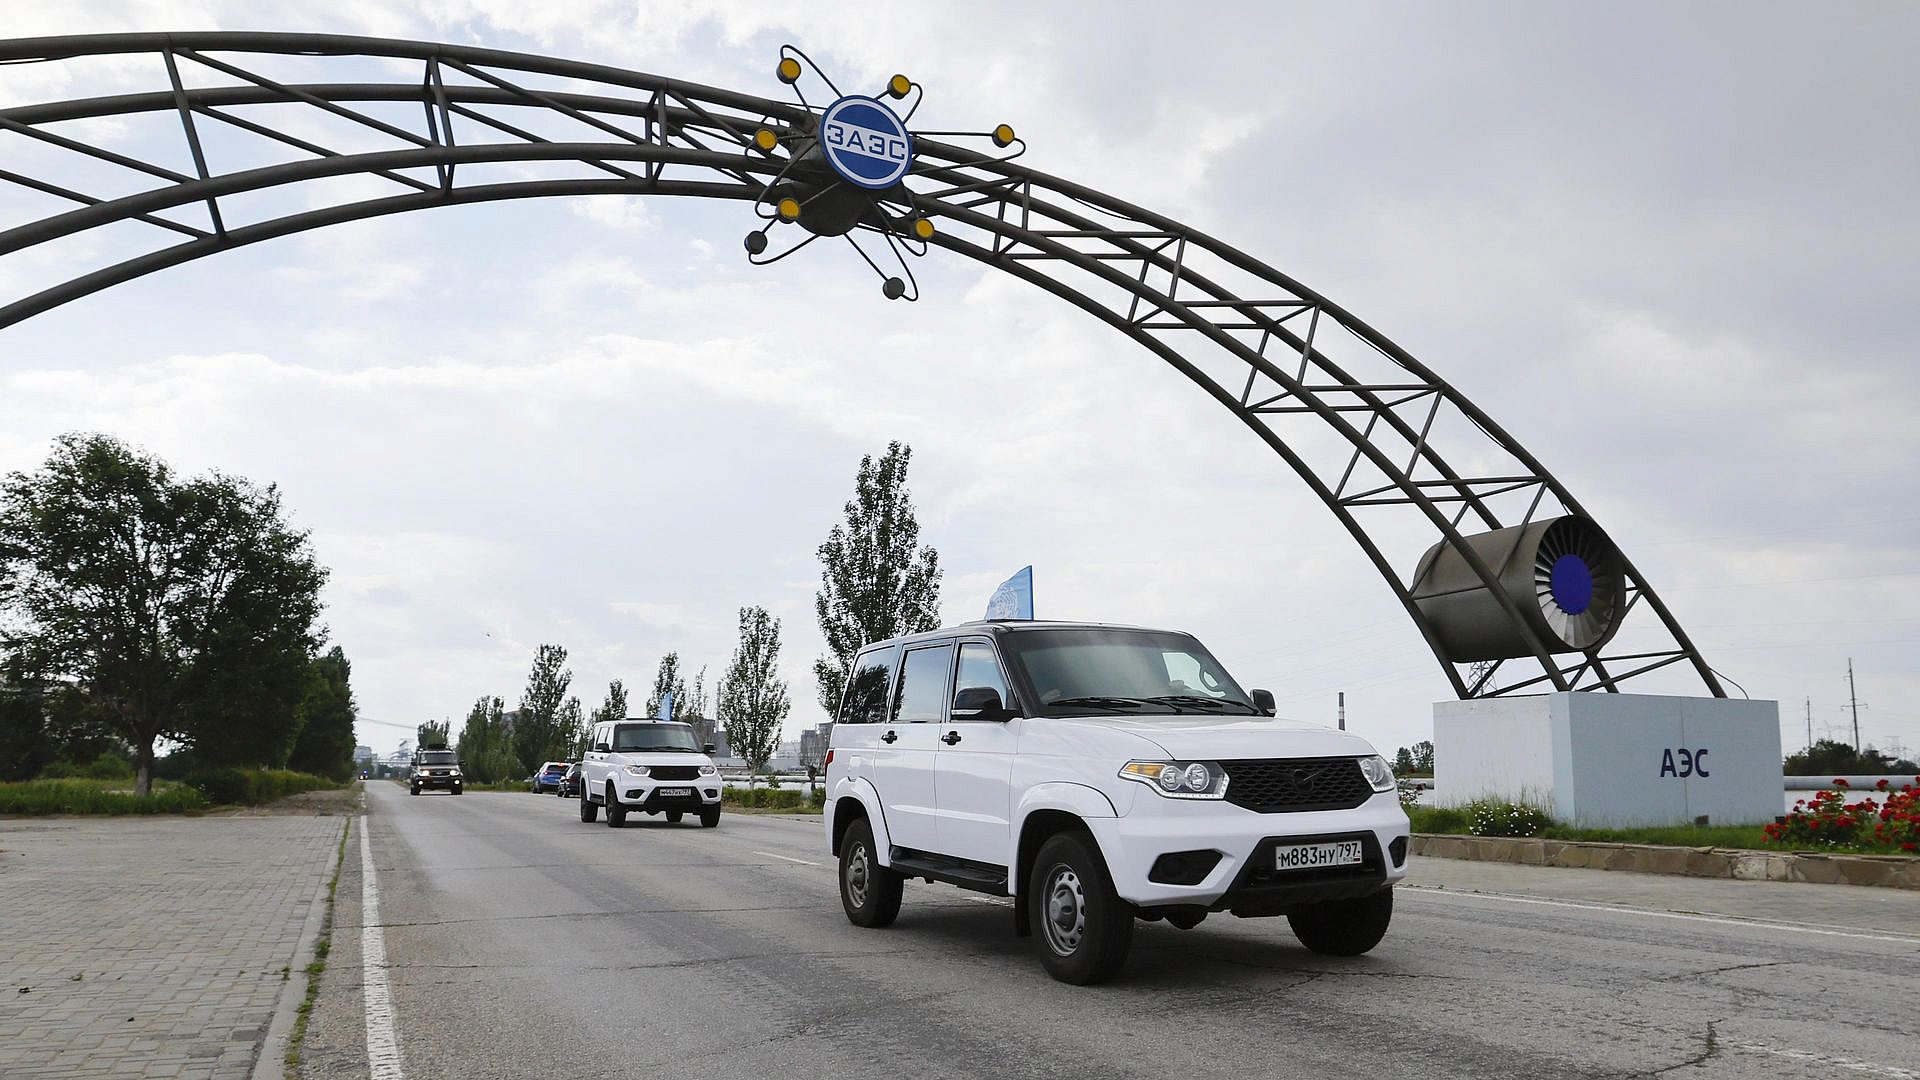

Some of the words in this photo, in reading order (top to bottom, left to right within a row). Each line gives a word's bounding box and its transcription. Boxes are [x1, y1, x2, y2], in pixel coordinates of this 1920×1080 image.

[827, 123, 905, 160] ЗАЭС
[1660, 748, 1710, 778] АЭС
[1280, 847, 1336, 867] М883НУ
[1338, 842, 1358, 858] 797
